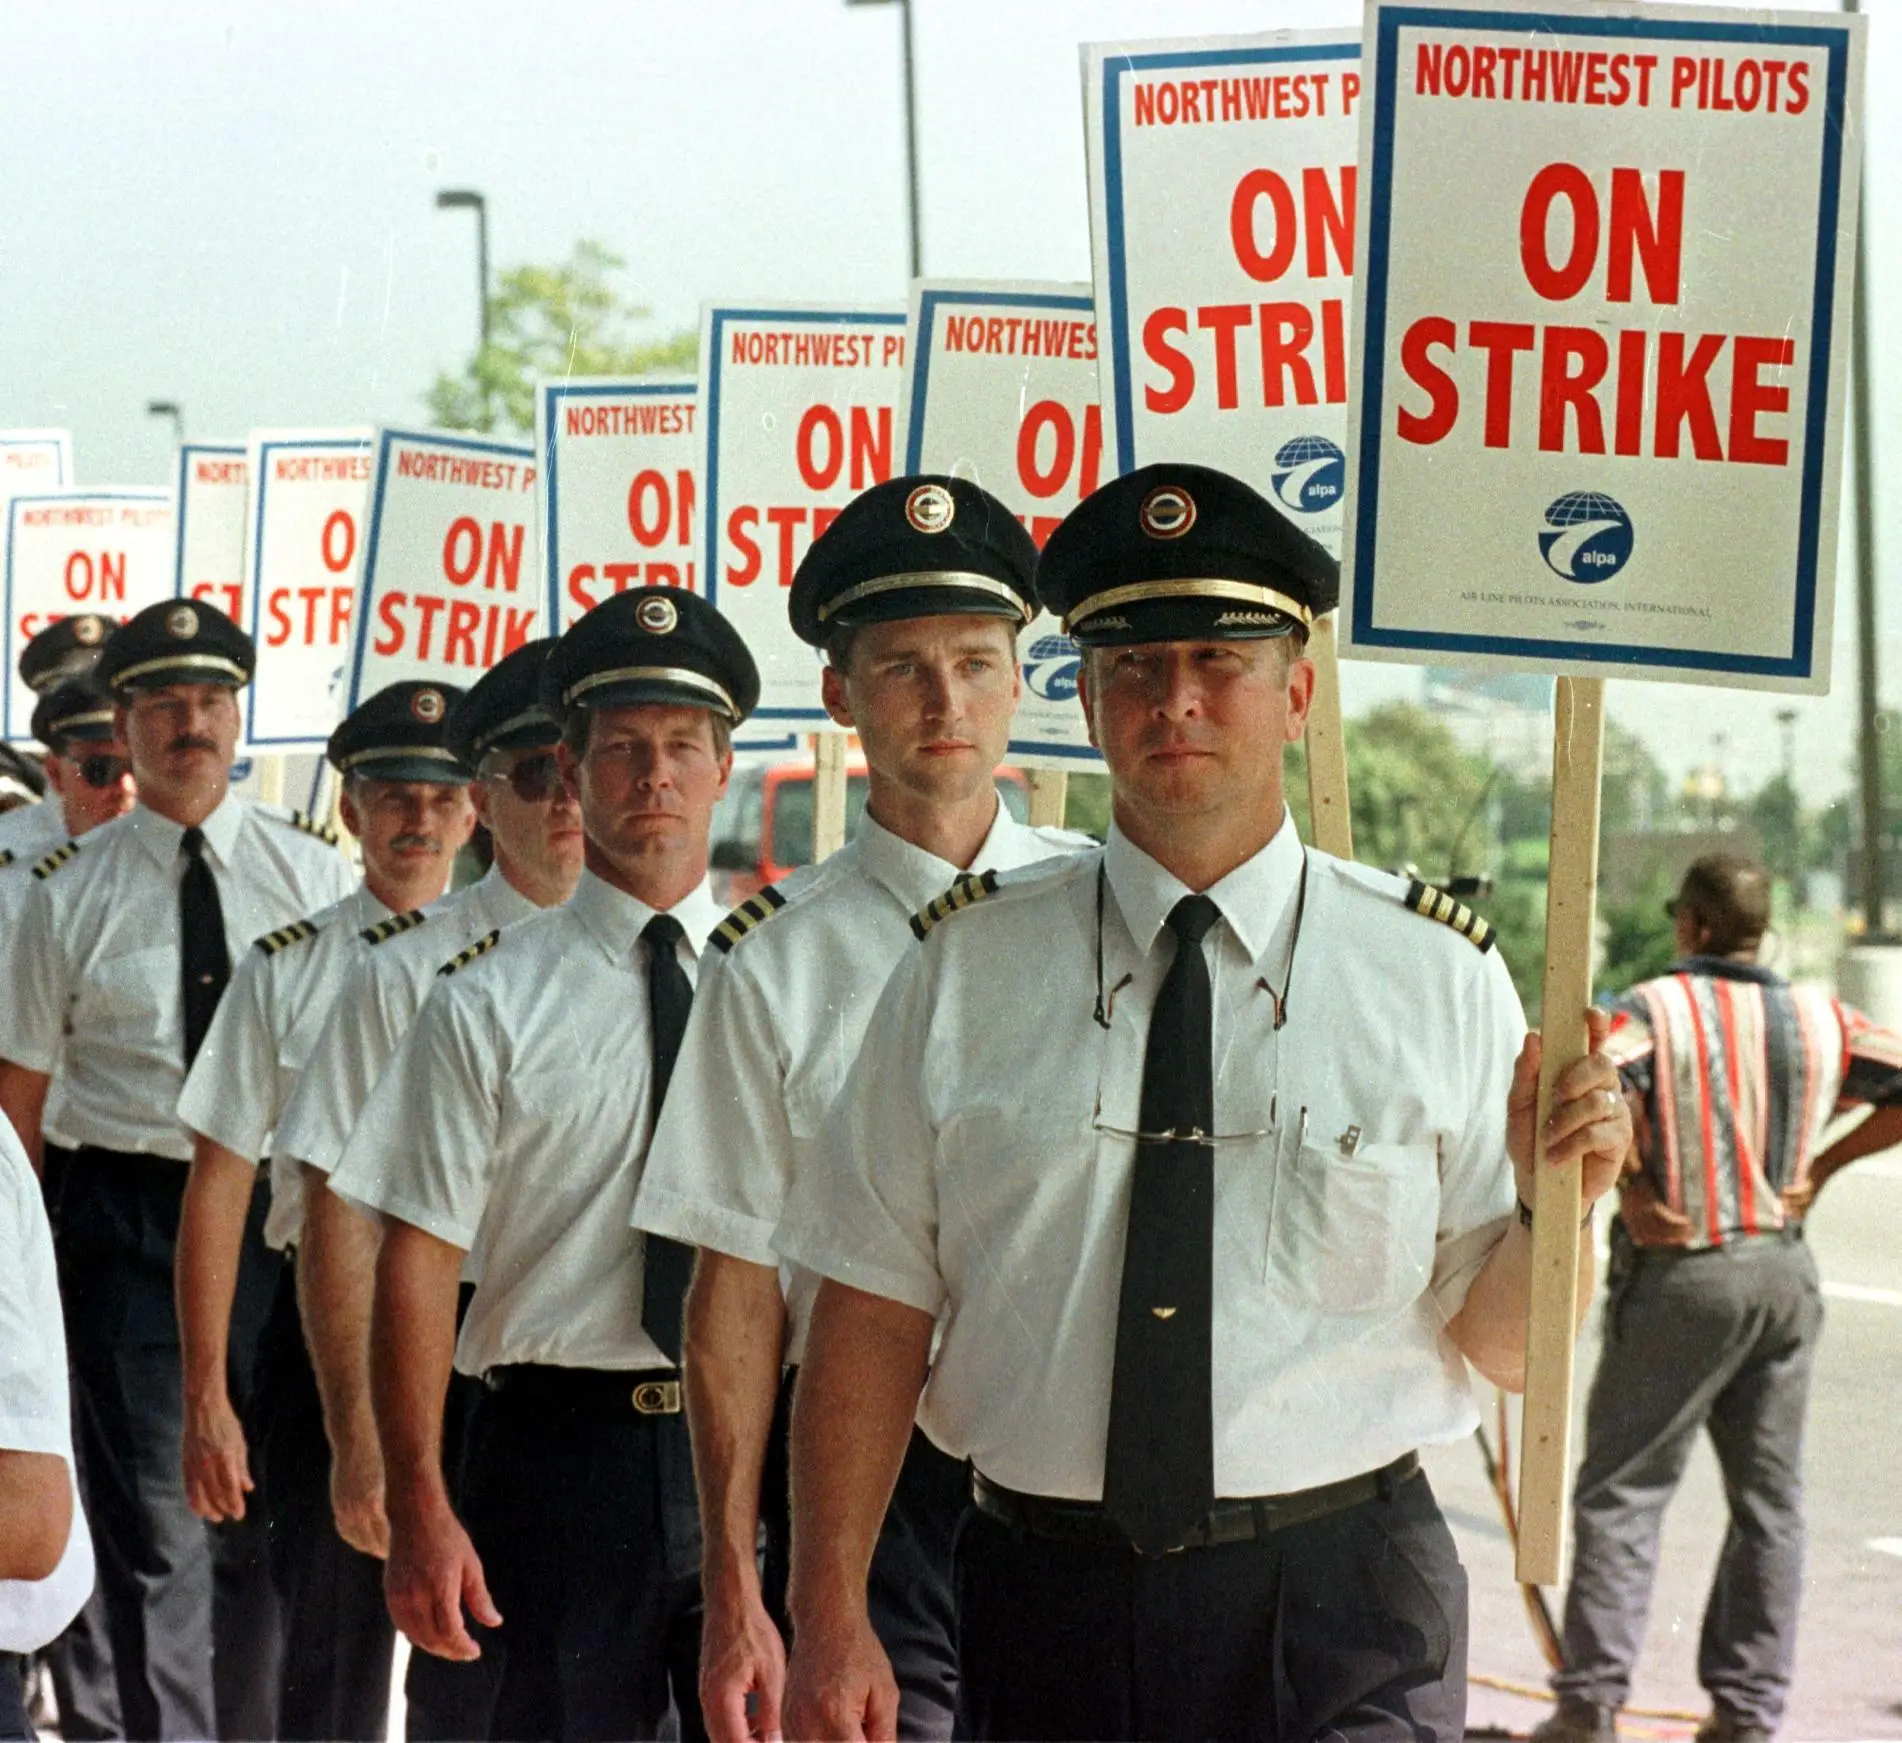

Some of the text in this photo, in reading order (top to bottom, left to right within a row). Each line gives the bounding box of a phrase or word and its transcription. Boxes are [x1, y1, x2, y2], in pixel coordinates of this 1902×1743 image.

[1134, 74, 1330, 127] NORTHWEST
[1416, 43, 1658, 108] NORTHWEST
[1670, 56, 1810, 115] PILOTS
[1231, 166, 1357, 283] ON
[1520, 162, 1687, 306] ON
[732, 332, 875, 367] NORTHWEST
[945, 316, 1098, 360] NORTHWES
[1143, 299, 1347, 414] STRI
[567, 404, 697, 436] NORTHWEST
[1397, 316, 1795, 467] STRIKE
[276, 456, 370, 481] NORTHWES
[397, 451, 515, 490] NORTHWEST
[796, 404, 893, 492] ON
[1308, 484, 1337, 498] alpa
[321, 509, 357, 574] O
[443, 517, 525, 593] ON
[1582, 550, 1617, 568] alpa
[65, 550, 126, 602] ON
[266, 587, 355, 649] STR
[374, 591, 537, 669] STRIK
[1460, 592, 1478, 601] AIR
[1481, 592, 1504, 603] LINE
[1508, 594, 1545, 606] PILOTS
[1624, 601, 1712, 618] INTERNATIONAL
